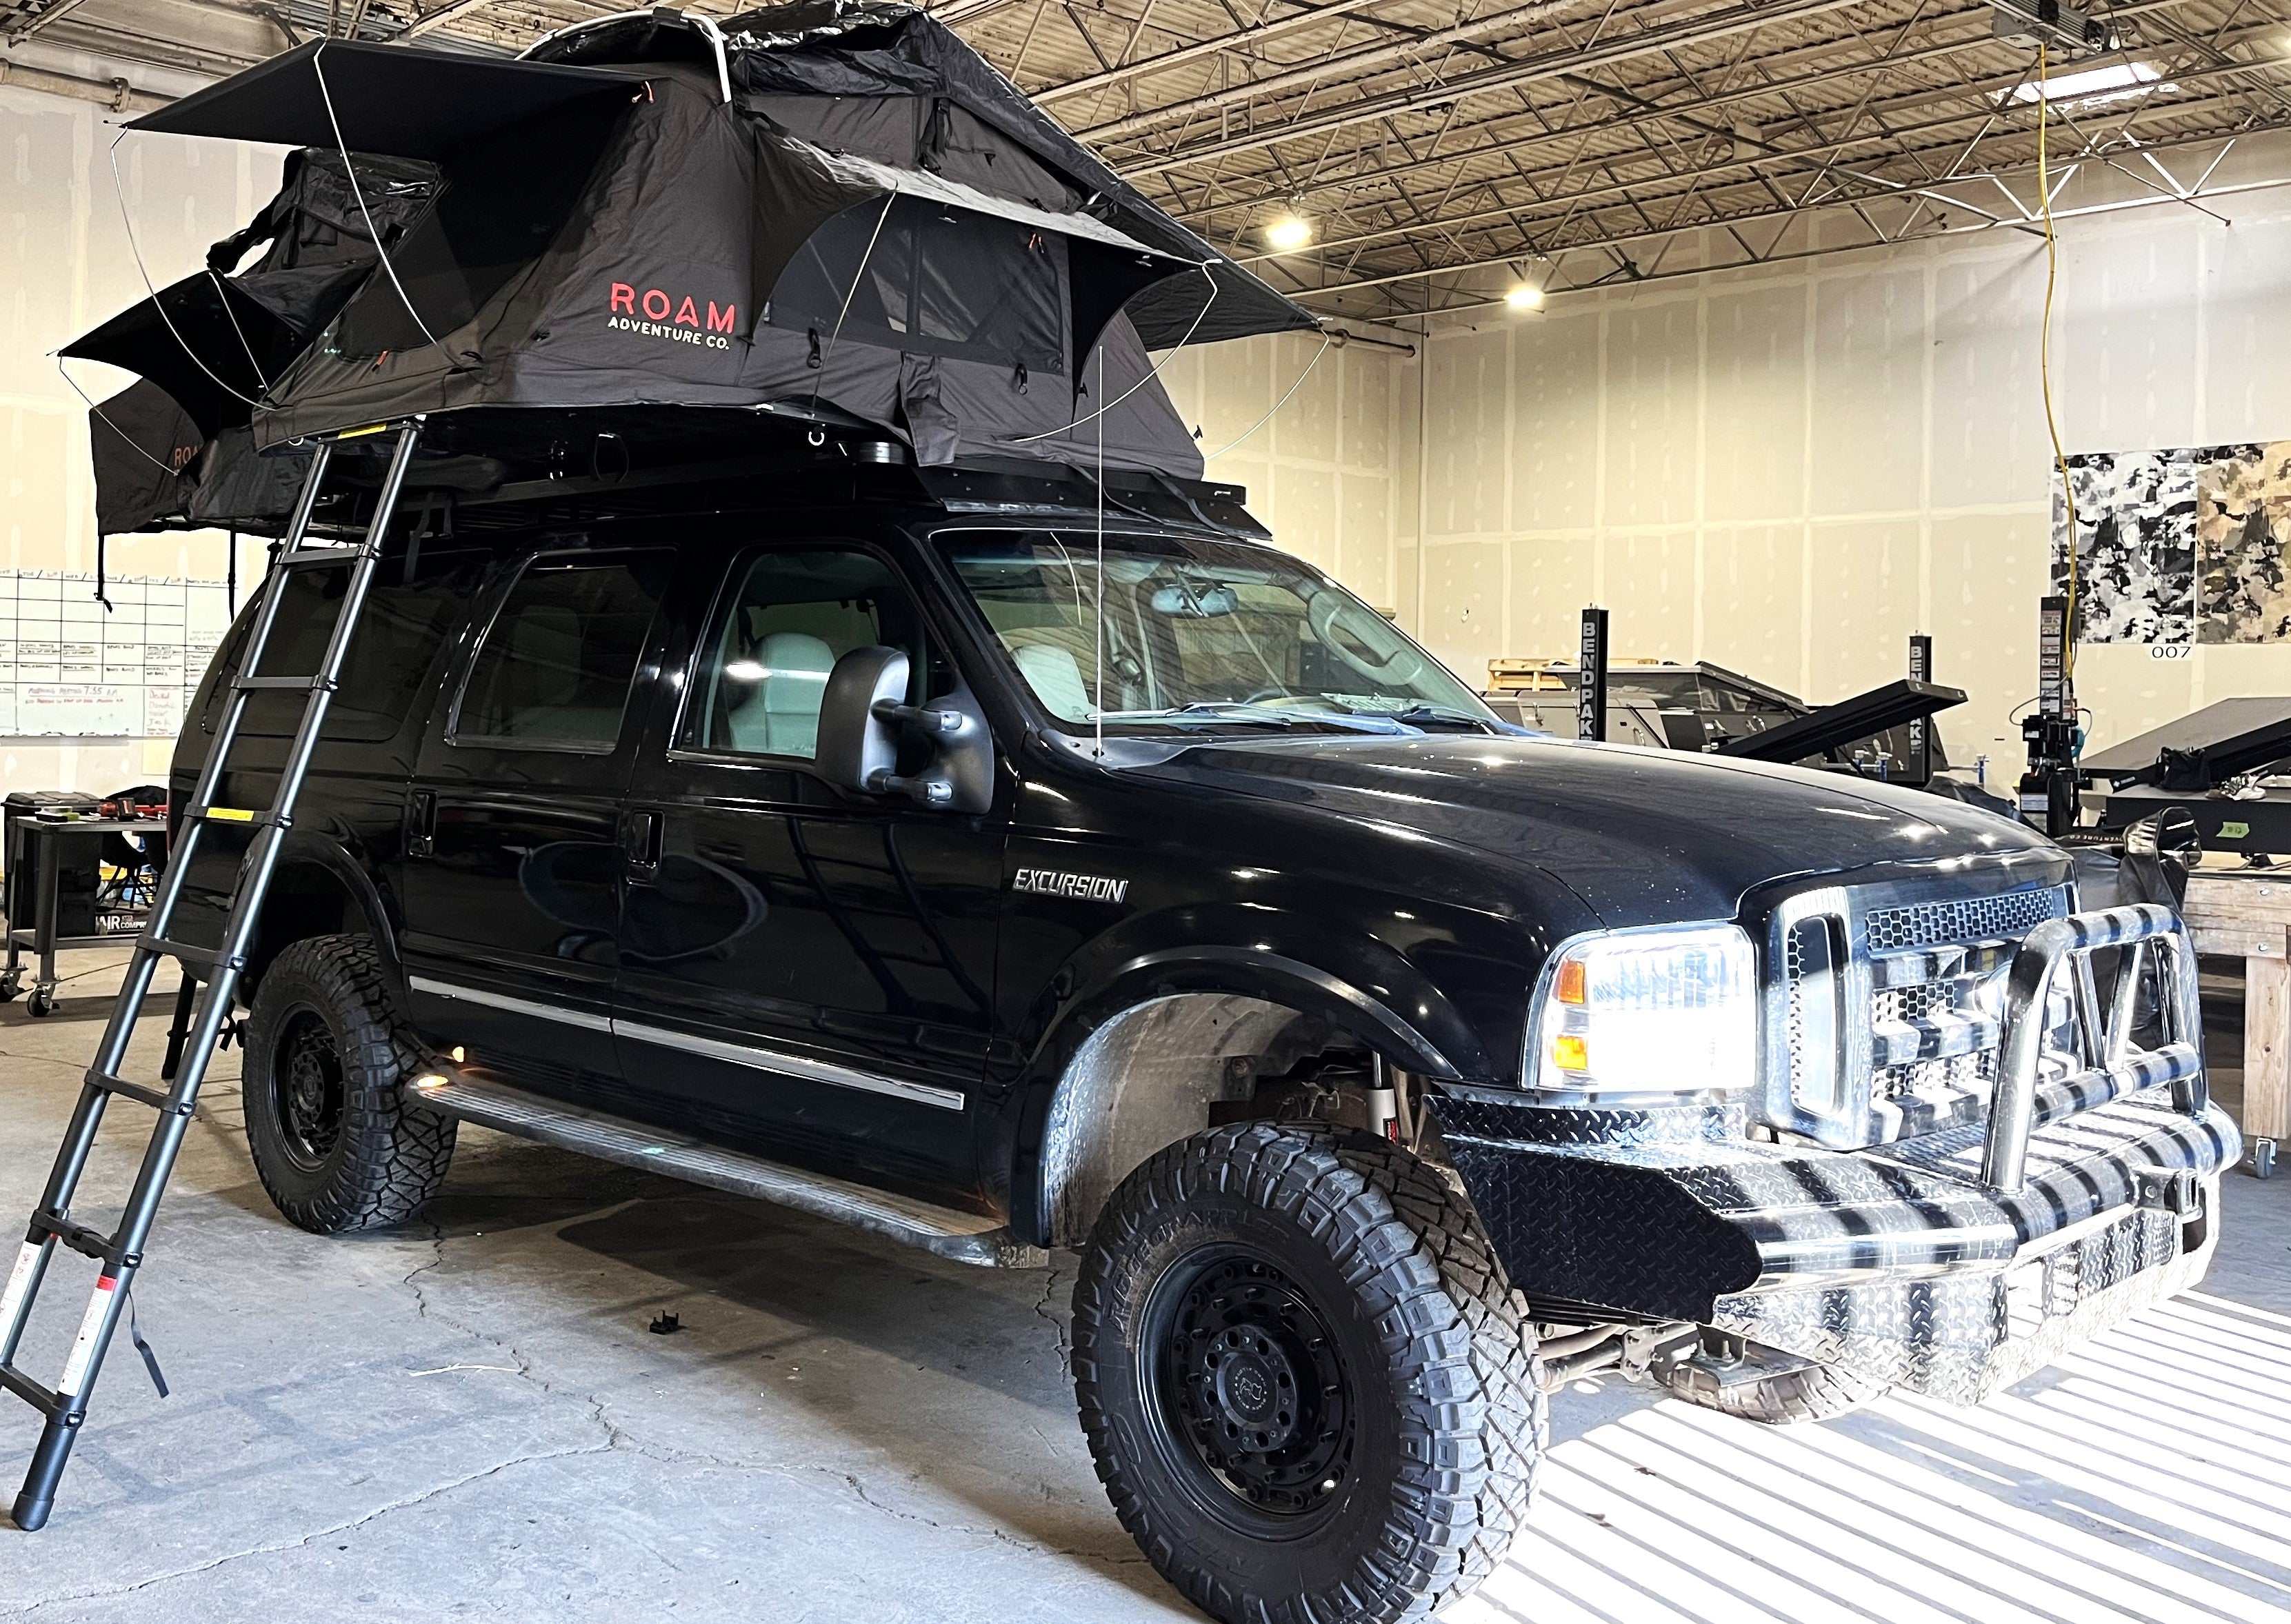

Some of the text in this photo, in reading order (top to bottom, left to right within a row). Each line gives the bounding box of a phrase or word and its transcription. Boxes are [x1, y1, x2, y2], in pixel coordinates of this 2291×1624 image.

[610, 282, 735, 334] ROAM
[608, 316, 730, 350] ADVENTURE CO.
[2152, 646, 2191, 659] 007
[1580, 622, 1596, 735] BENDPAK
[1012, 868, 1129, 904] EXCURSION
